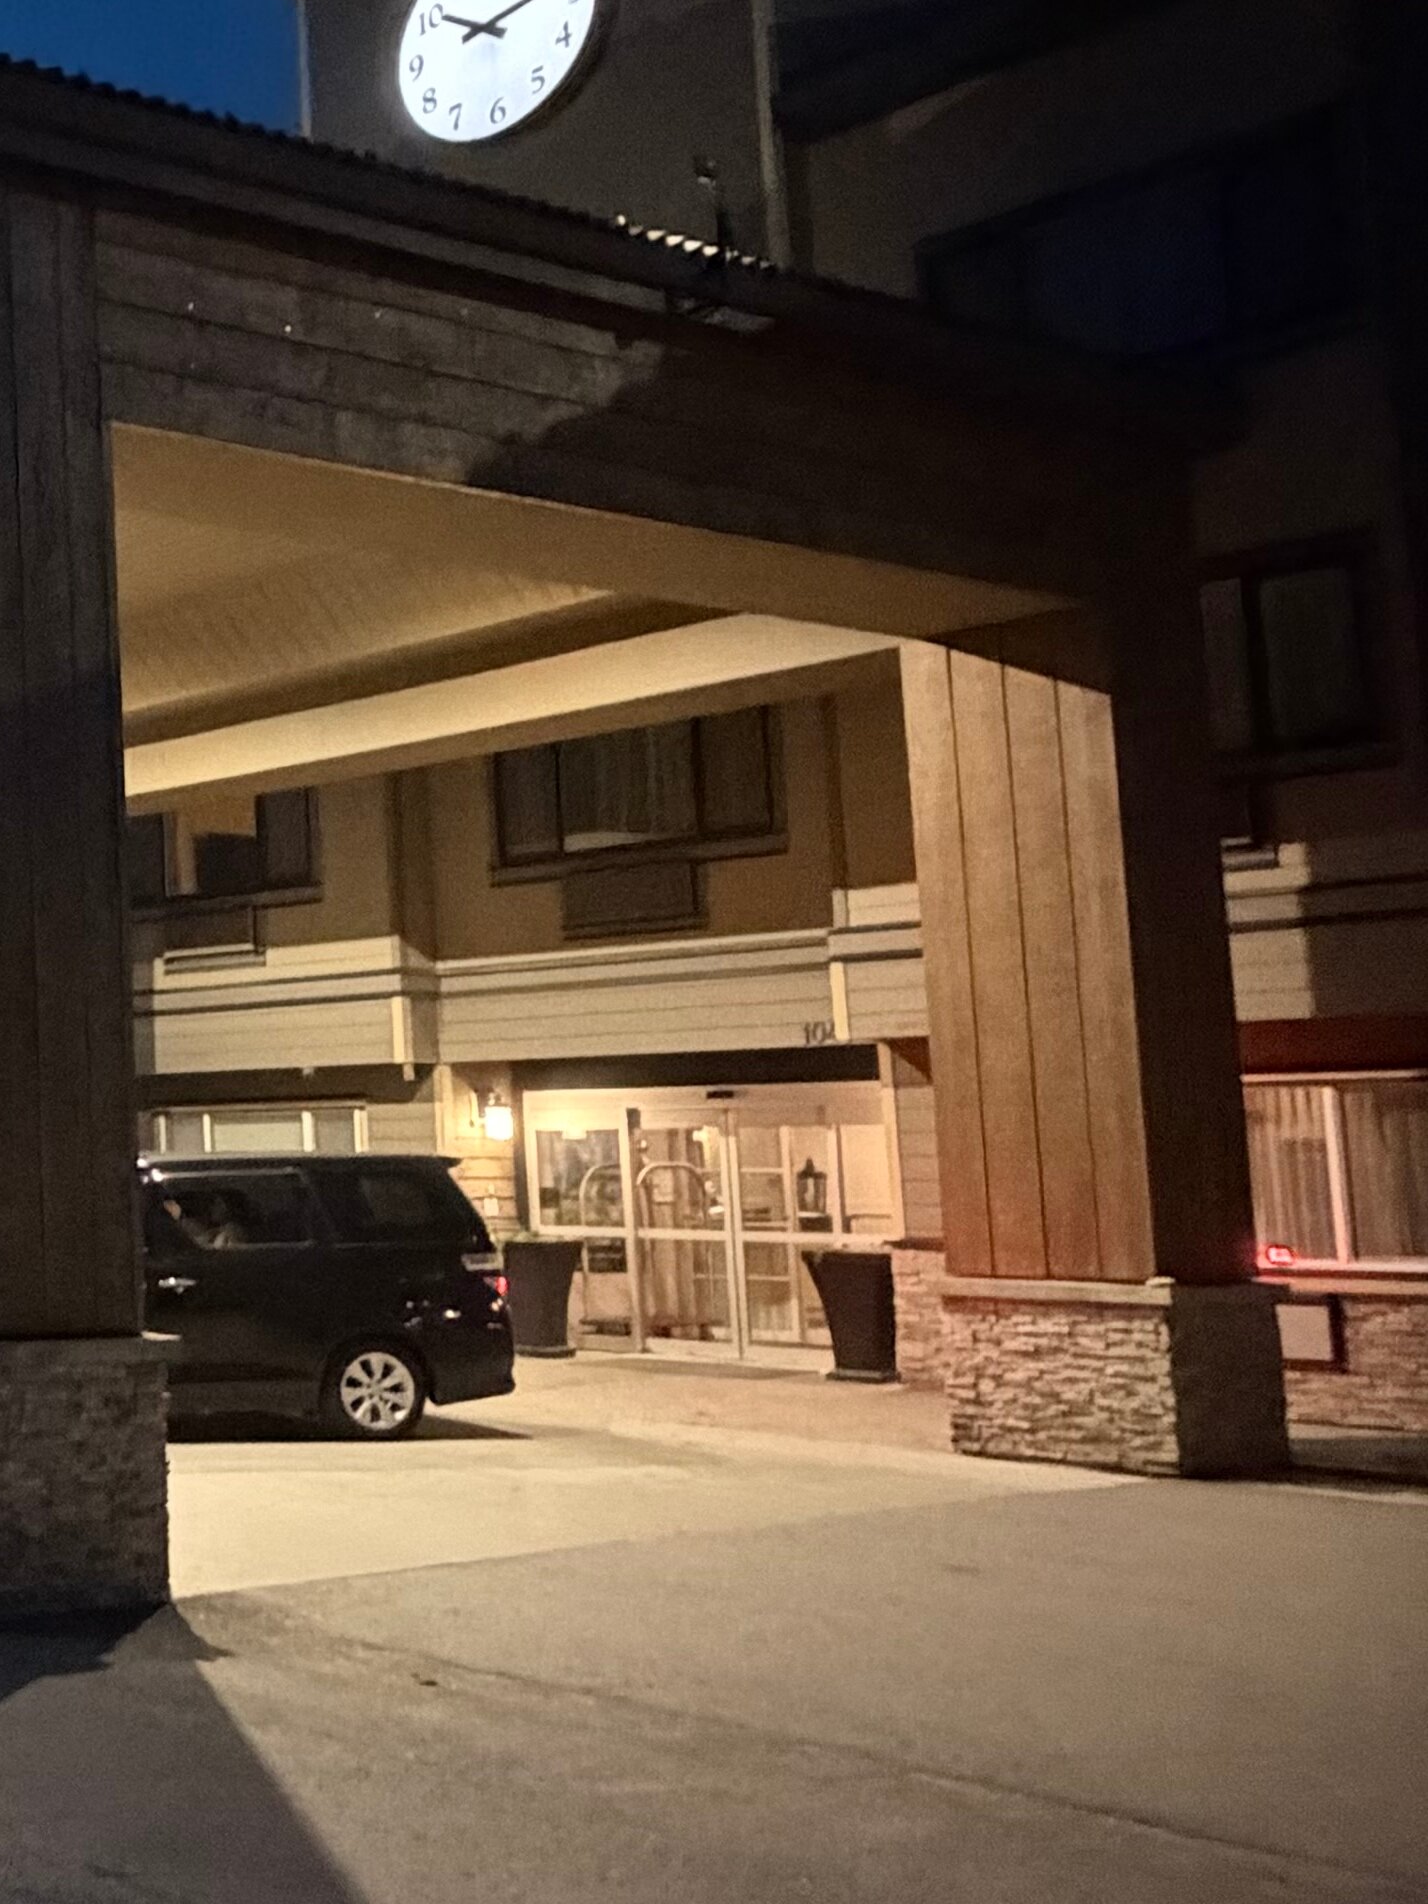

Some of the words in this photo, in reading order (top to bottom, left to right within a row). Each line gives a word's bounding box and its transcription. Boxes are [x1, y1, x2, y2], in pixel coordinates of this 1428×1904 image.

[417, 3, 444, 36] 10
[555, 21, 571, 48] 4
[408, 54, 424, 80] 9
[531, 65, 546, 94] 5
[422, 87, 438, 114] 8
[490, 97, 506, 125] 6
[449, 103, 463, 131] 7
